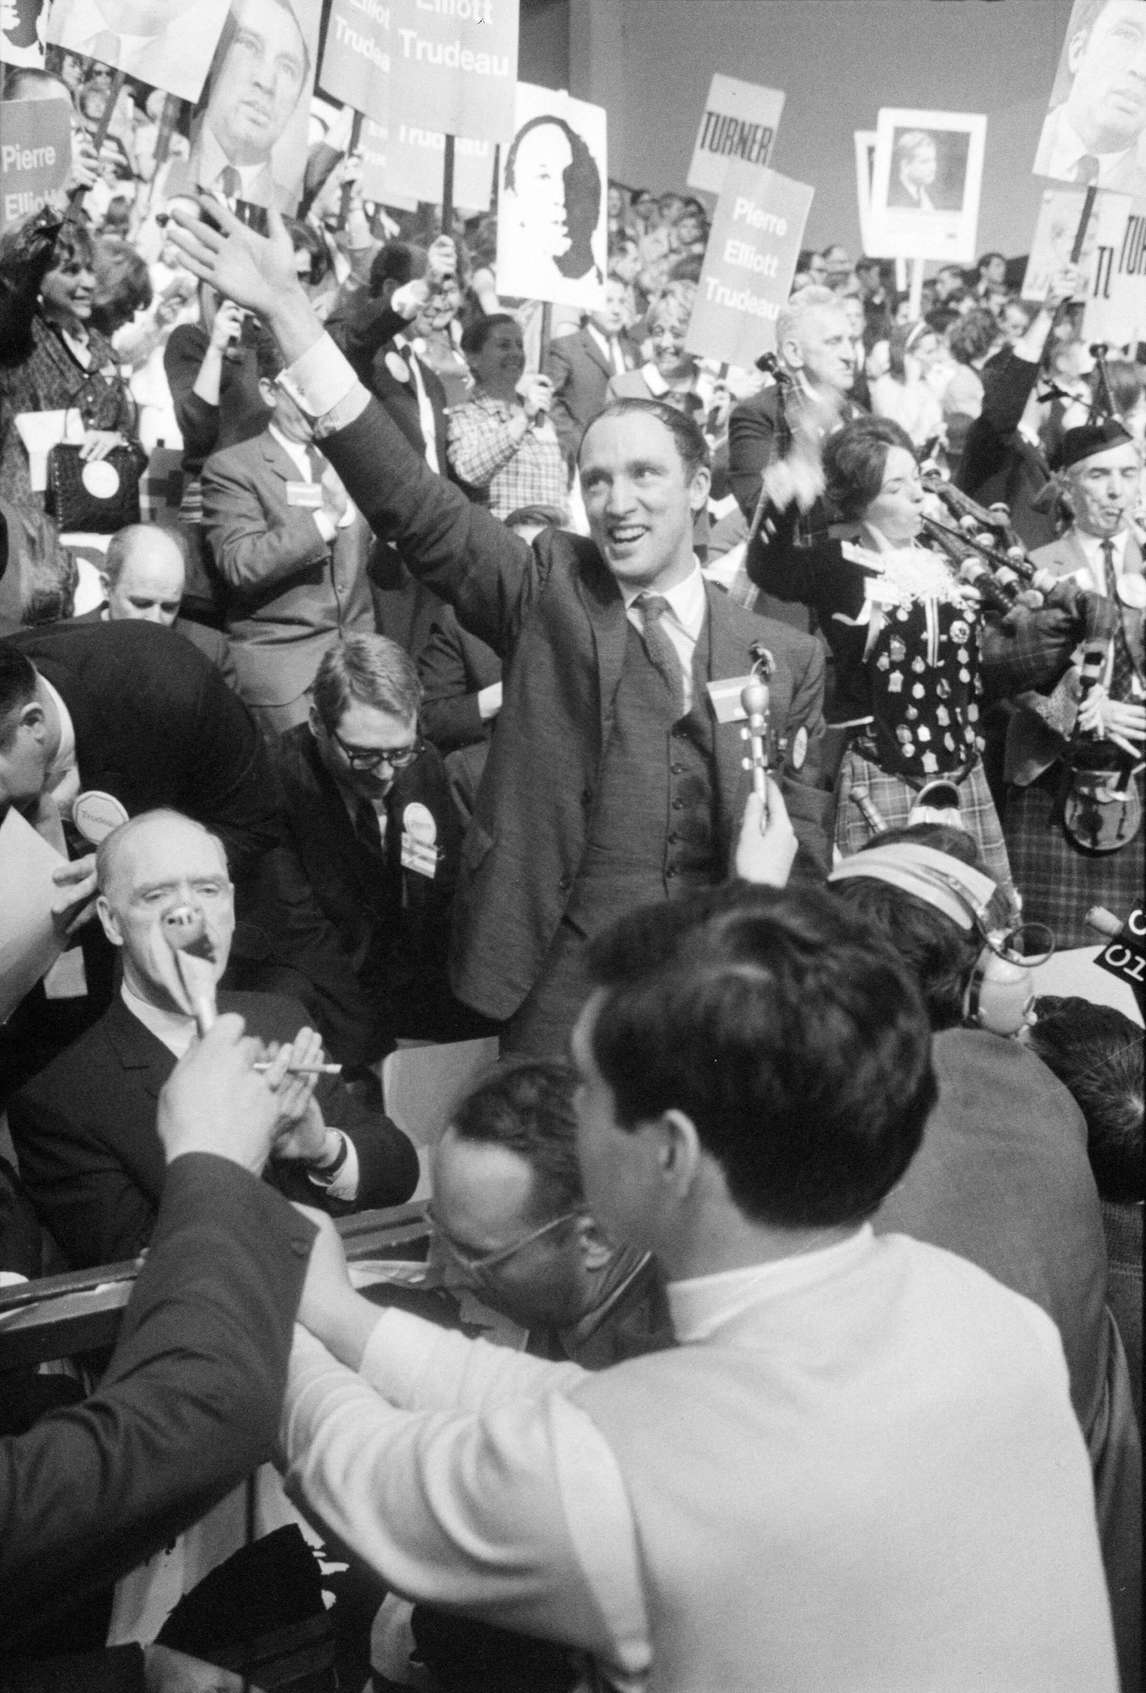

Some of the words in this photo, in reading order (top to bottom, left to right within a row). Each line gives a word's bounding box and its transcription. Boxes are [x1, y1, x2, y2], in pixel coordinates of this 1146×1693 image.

[398, 27, 510, 76] Trudeau
[1, 143, 56, 172] Pierre
[701, 111, 773, 165] TURNER
[733, 197, 788, 236] Pierre
[723, 239, 779, 277] Elliott
[705, 276, 781, 320] Trudeau
